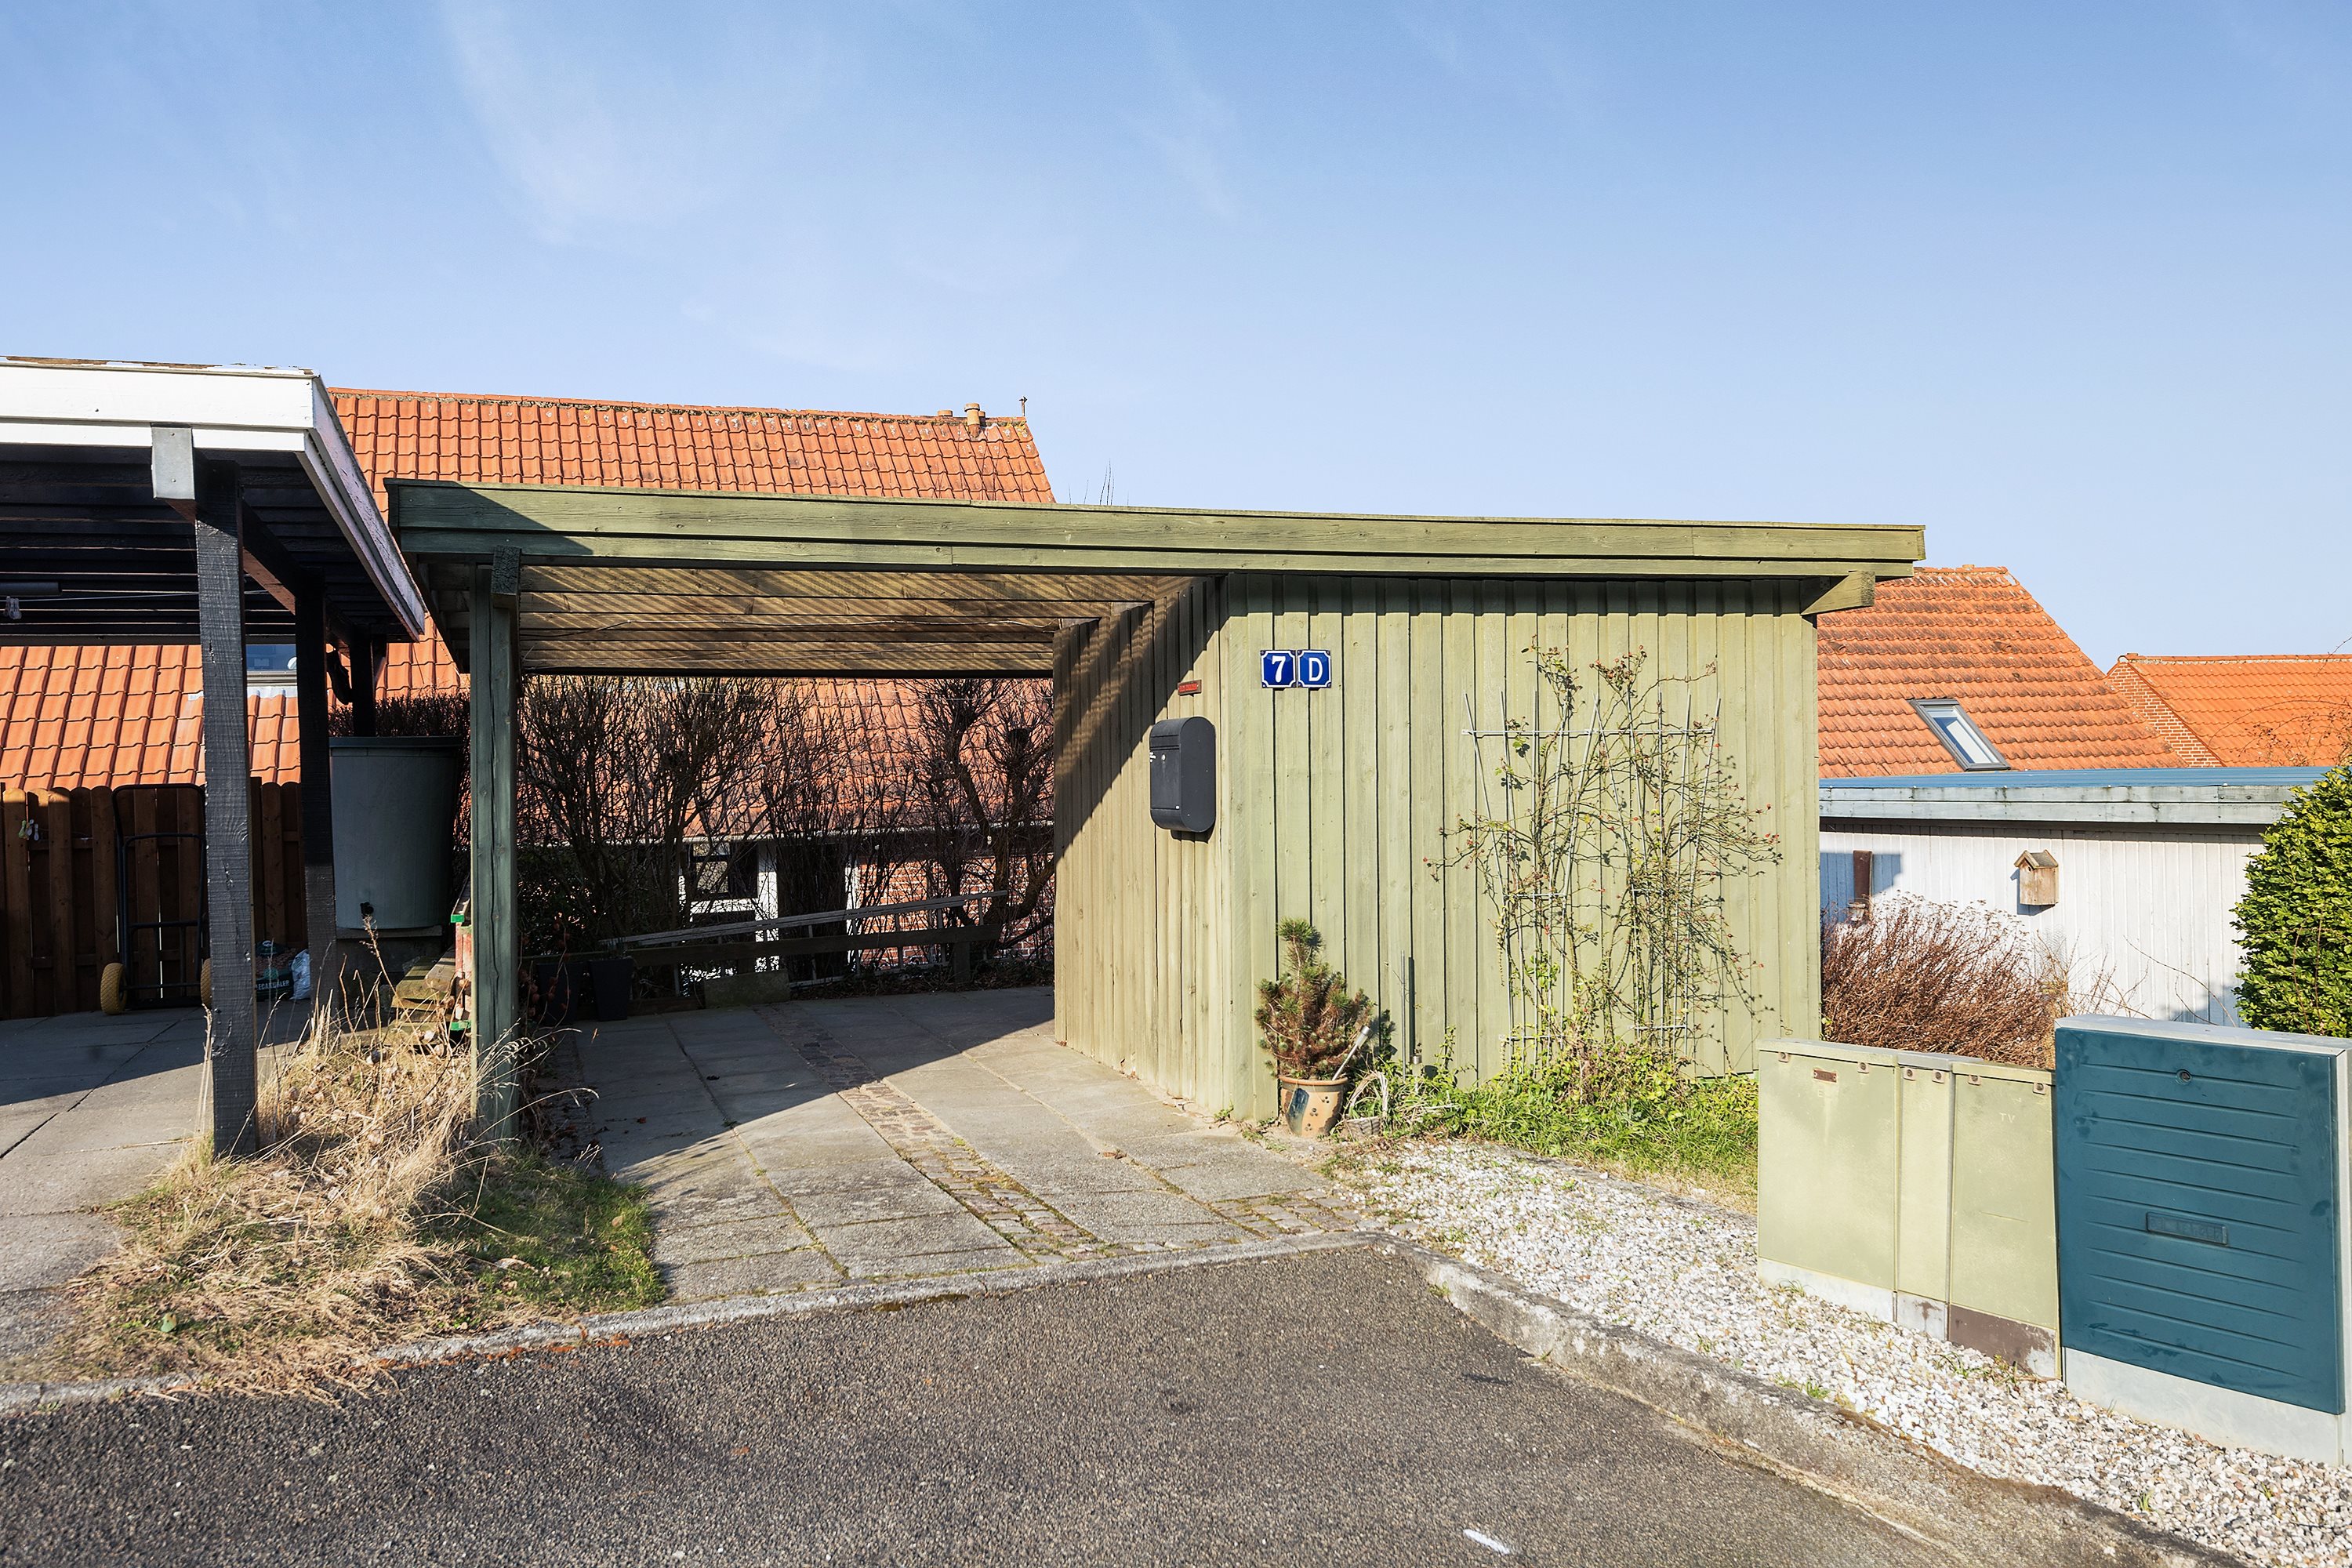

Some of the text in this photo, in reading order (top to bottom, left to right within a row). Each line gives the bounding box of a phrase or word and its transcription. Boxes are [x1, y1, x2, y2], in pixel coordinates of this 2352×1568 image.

[1272, 655, 1323, 683] 7 D
[1999, 1112, 2016, 1123] TV
